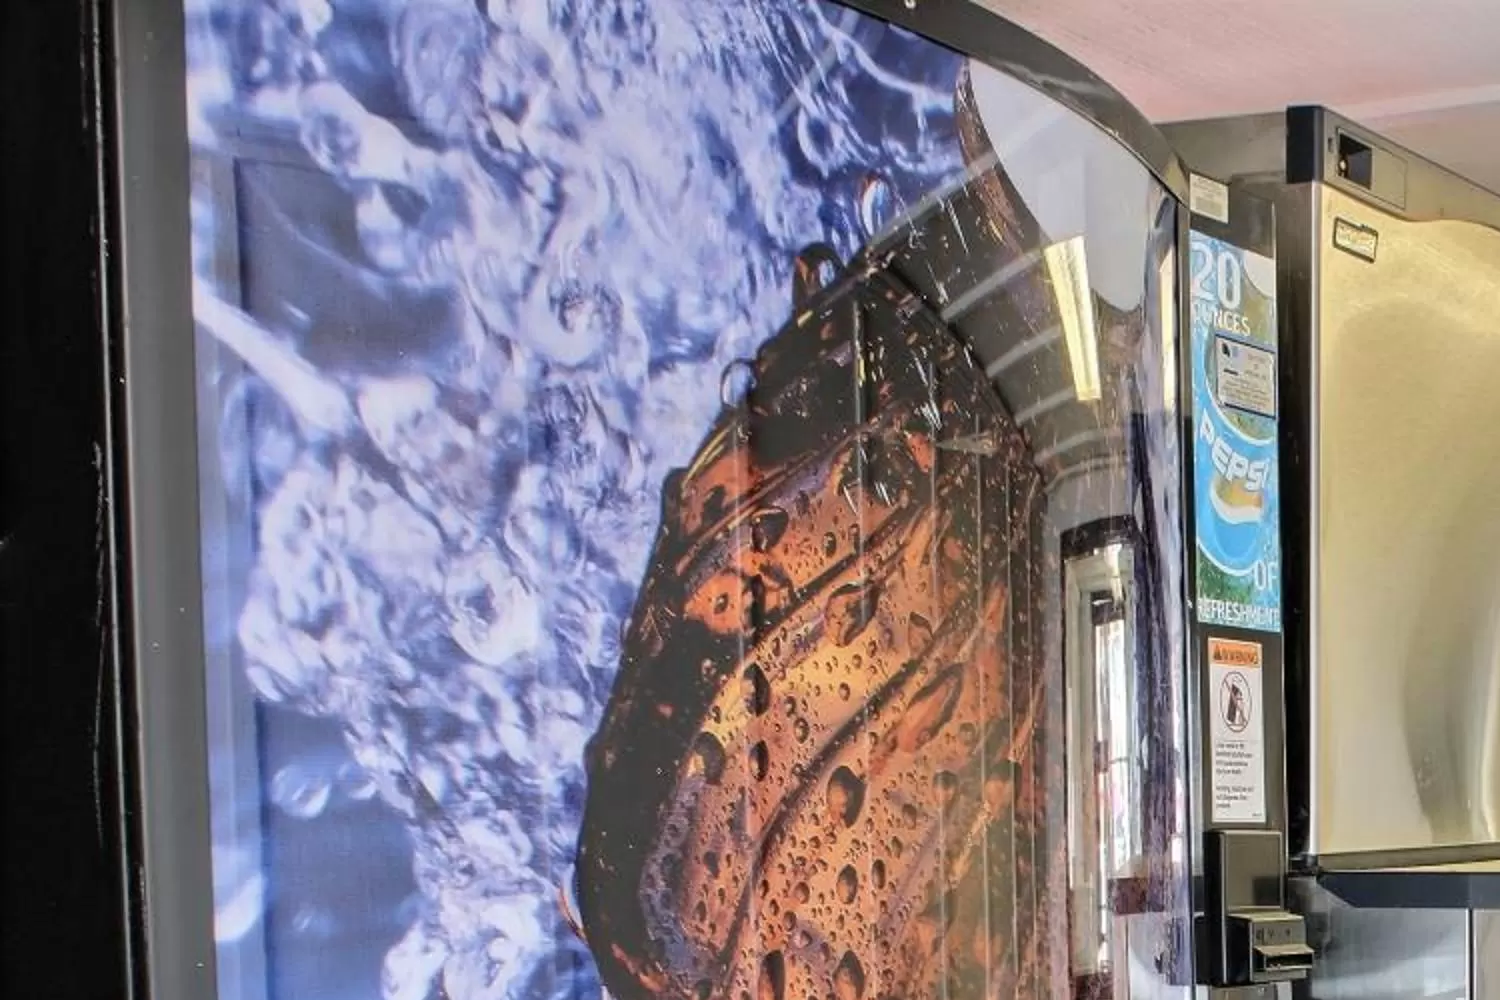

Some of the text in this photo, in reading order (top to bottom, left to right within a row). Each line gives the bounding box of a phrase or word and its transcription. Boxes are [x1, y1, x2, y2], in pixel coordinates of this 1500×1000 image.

[1191, 241, 1241, 310] 20
[1200, 408, 1271, 489] PEPSI
[1255, 560, 1278, 591] OF
